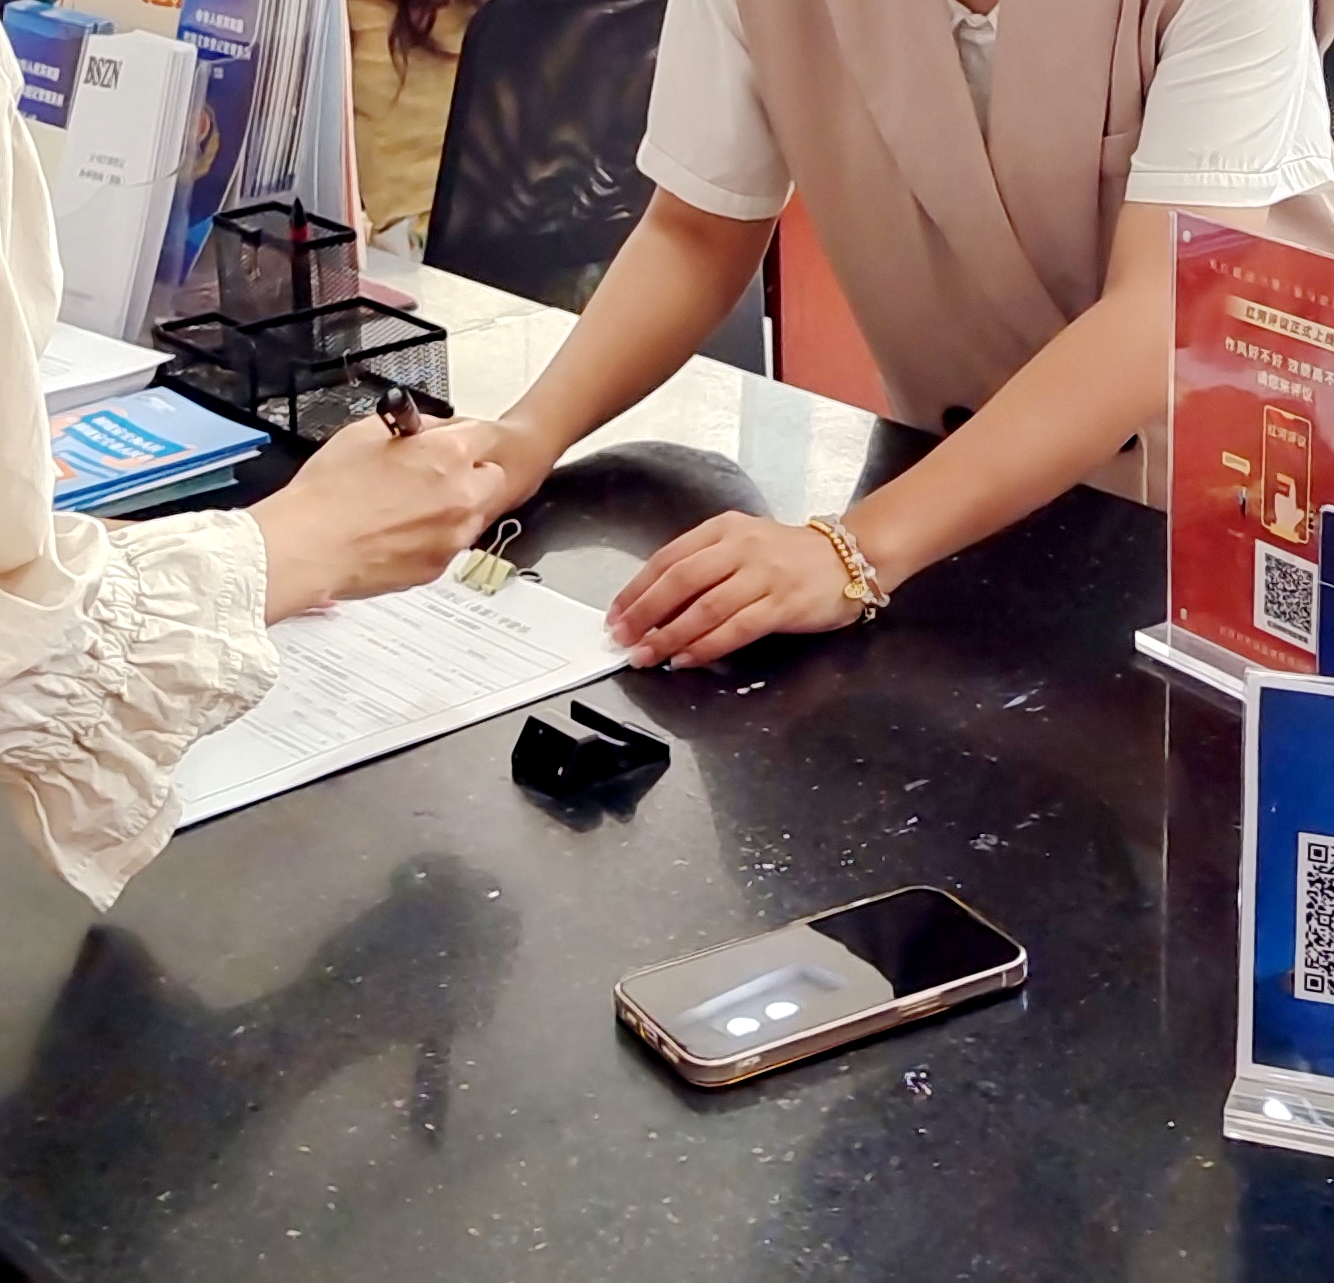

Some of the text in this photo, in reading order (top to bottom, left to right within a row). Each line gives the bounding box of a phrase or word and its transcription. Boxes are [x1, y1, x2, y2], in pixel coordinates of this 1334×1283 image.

[1224, 336, 1284, 369] 作风好不好
